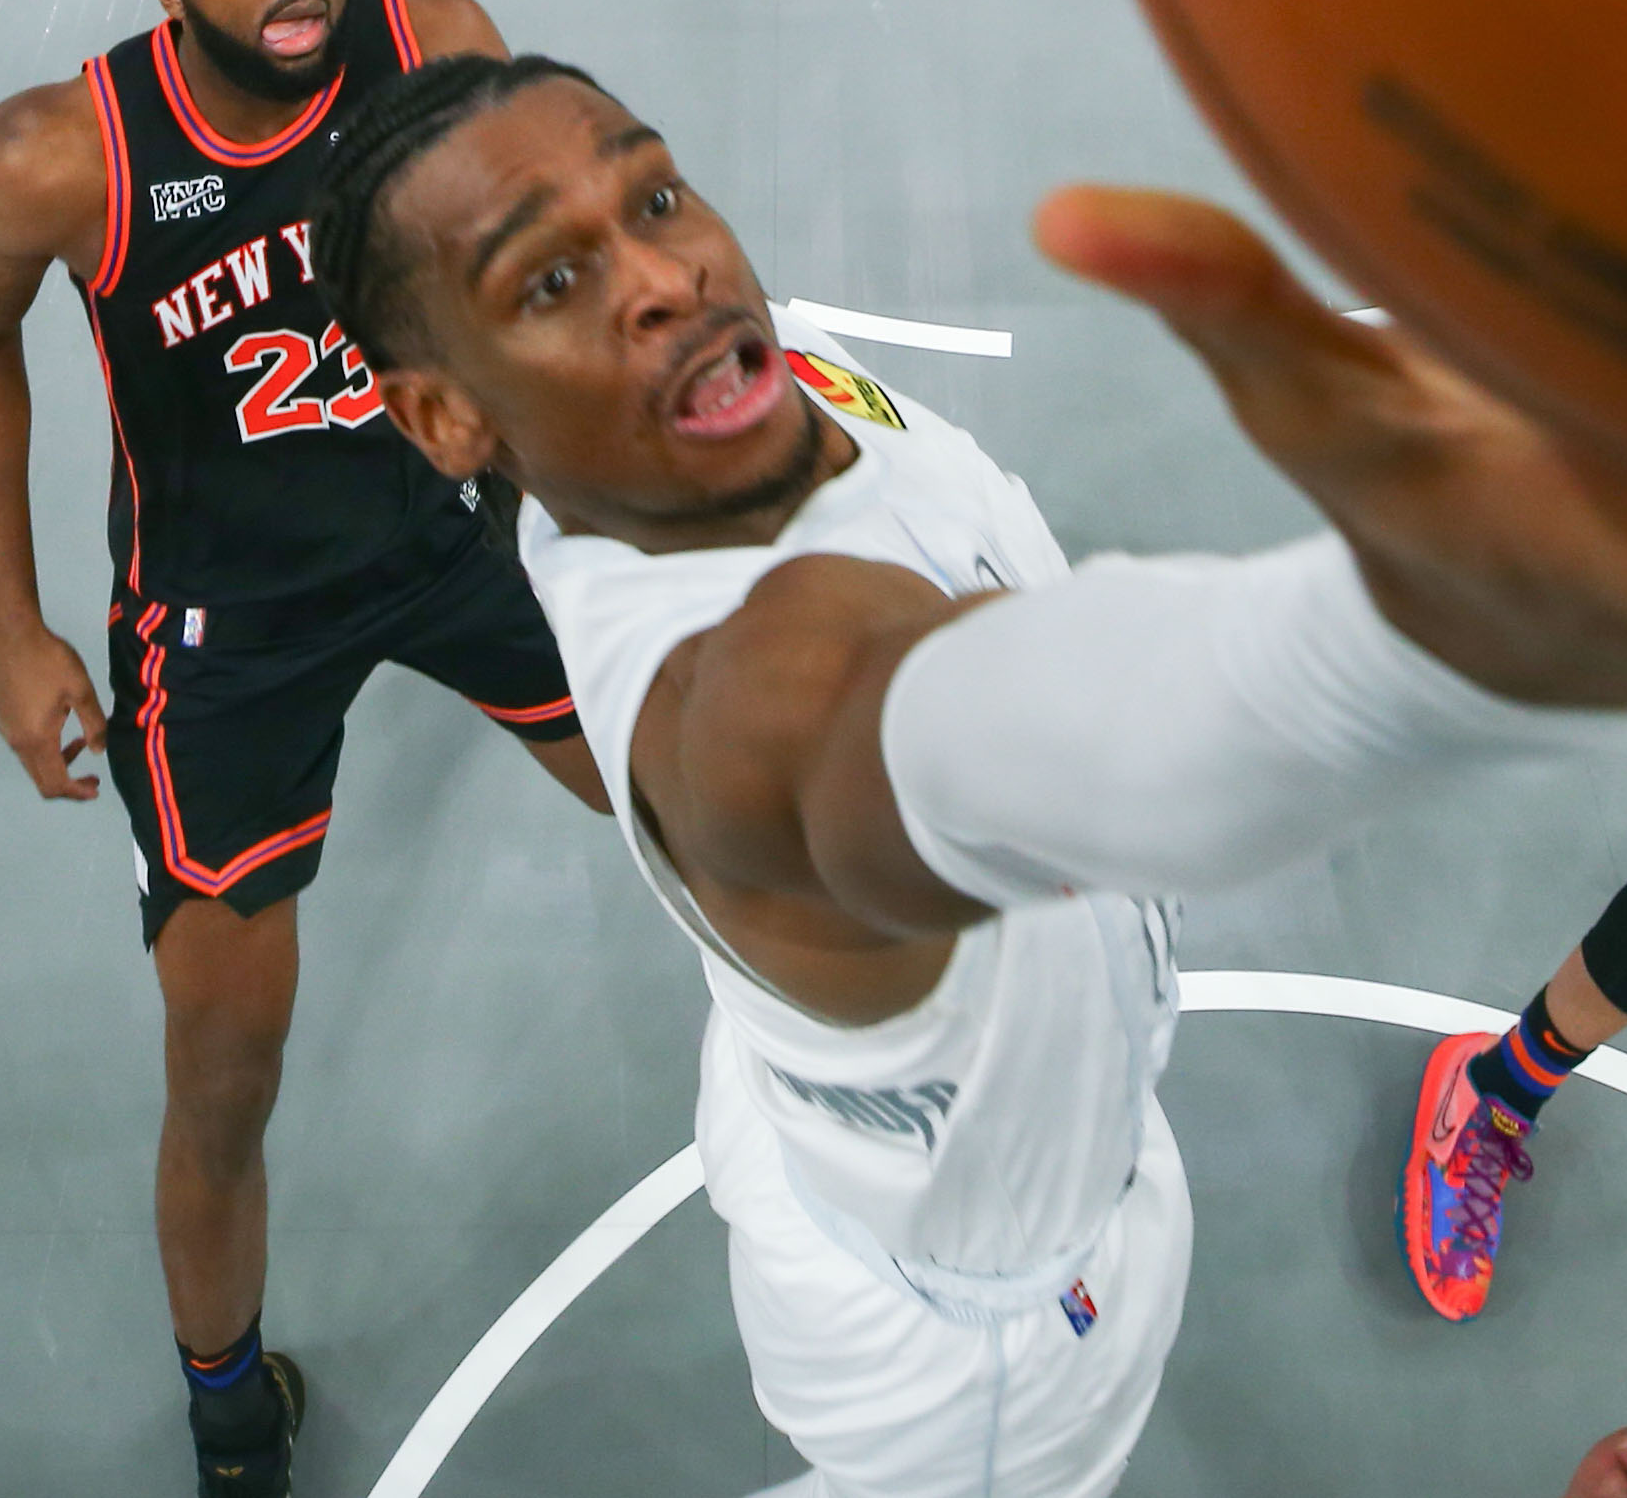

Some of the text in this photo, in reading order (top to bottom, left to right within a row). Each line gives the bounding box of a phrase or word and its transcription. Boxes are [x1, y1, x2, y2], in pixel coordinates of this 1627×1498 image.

[150, 174, 226, 222] NYC
[151, 235, 273, 350] NEW
[223, 319, 386, 444] 23
